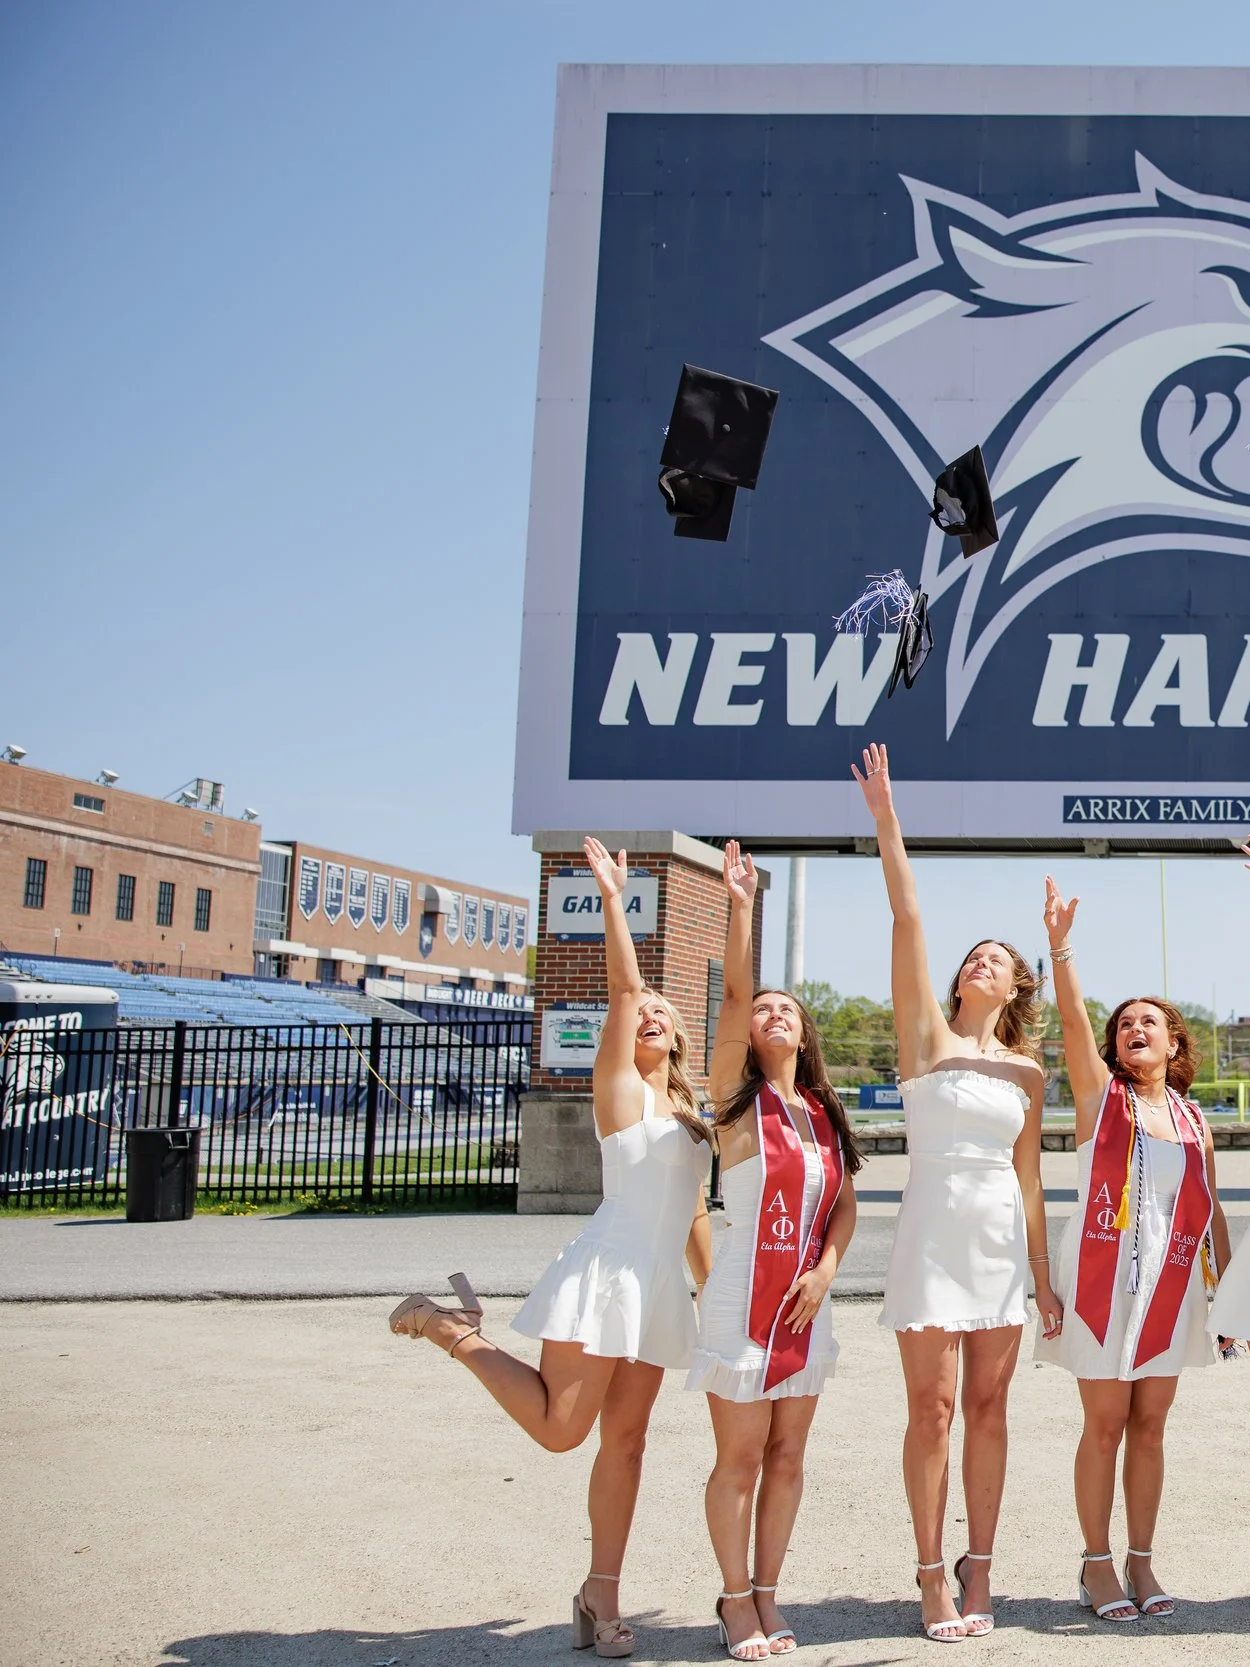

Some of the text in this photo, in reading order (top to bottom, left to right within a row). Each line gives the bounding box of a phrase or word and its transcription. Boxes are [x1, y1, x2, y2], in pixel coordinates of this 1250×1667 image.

[598, 632, 901, 726] NEW
[1067, 799, 1151, 821] ARRIX
[562, 896, 642, 914] GAT A
[464, 989, 489, 1007] BEER
[492, 991, 515, 1009] DECK
[566, 1002, 595, 1010] Wildcat
[0, 1011, 82, 1046] COME TO
[28, 1087, 110, 1125] COUNTRY
[1086, 1230, 1117, 1242] Eta Alpha
[1173, 1231, 1197, 1246] CLASS
[761, 1241, 796, 1253] Eta Alpha
[1177, 1245, 1187, 1255] OF
[1169, 1252, 1190, 1267] 2025
